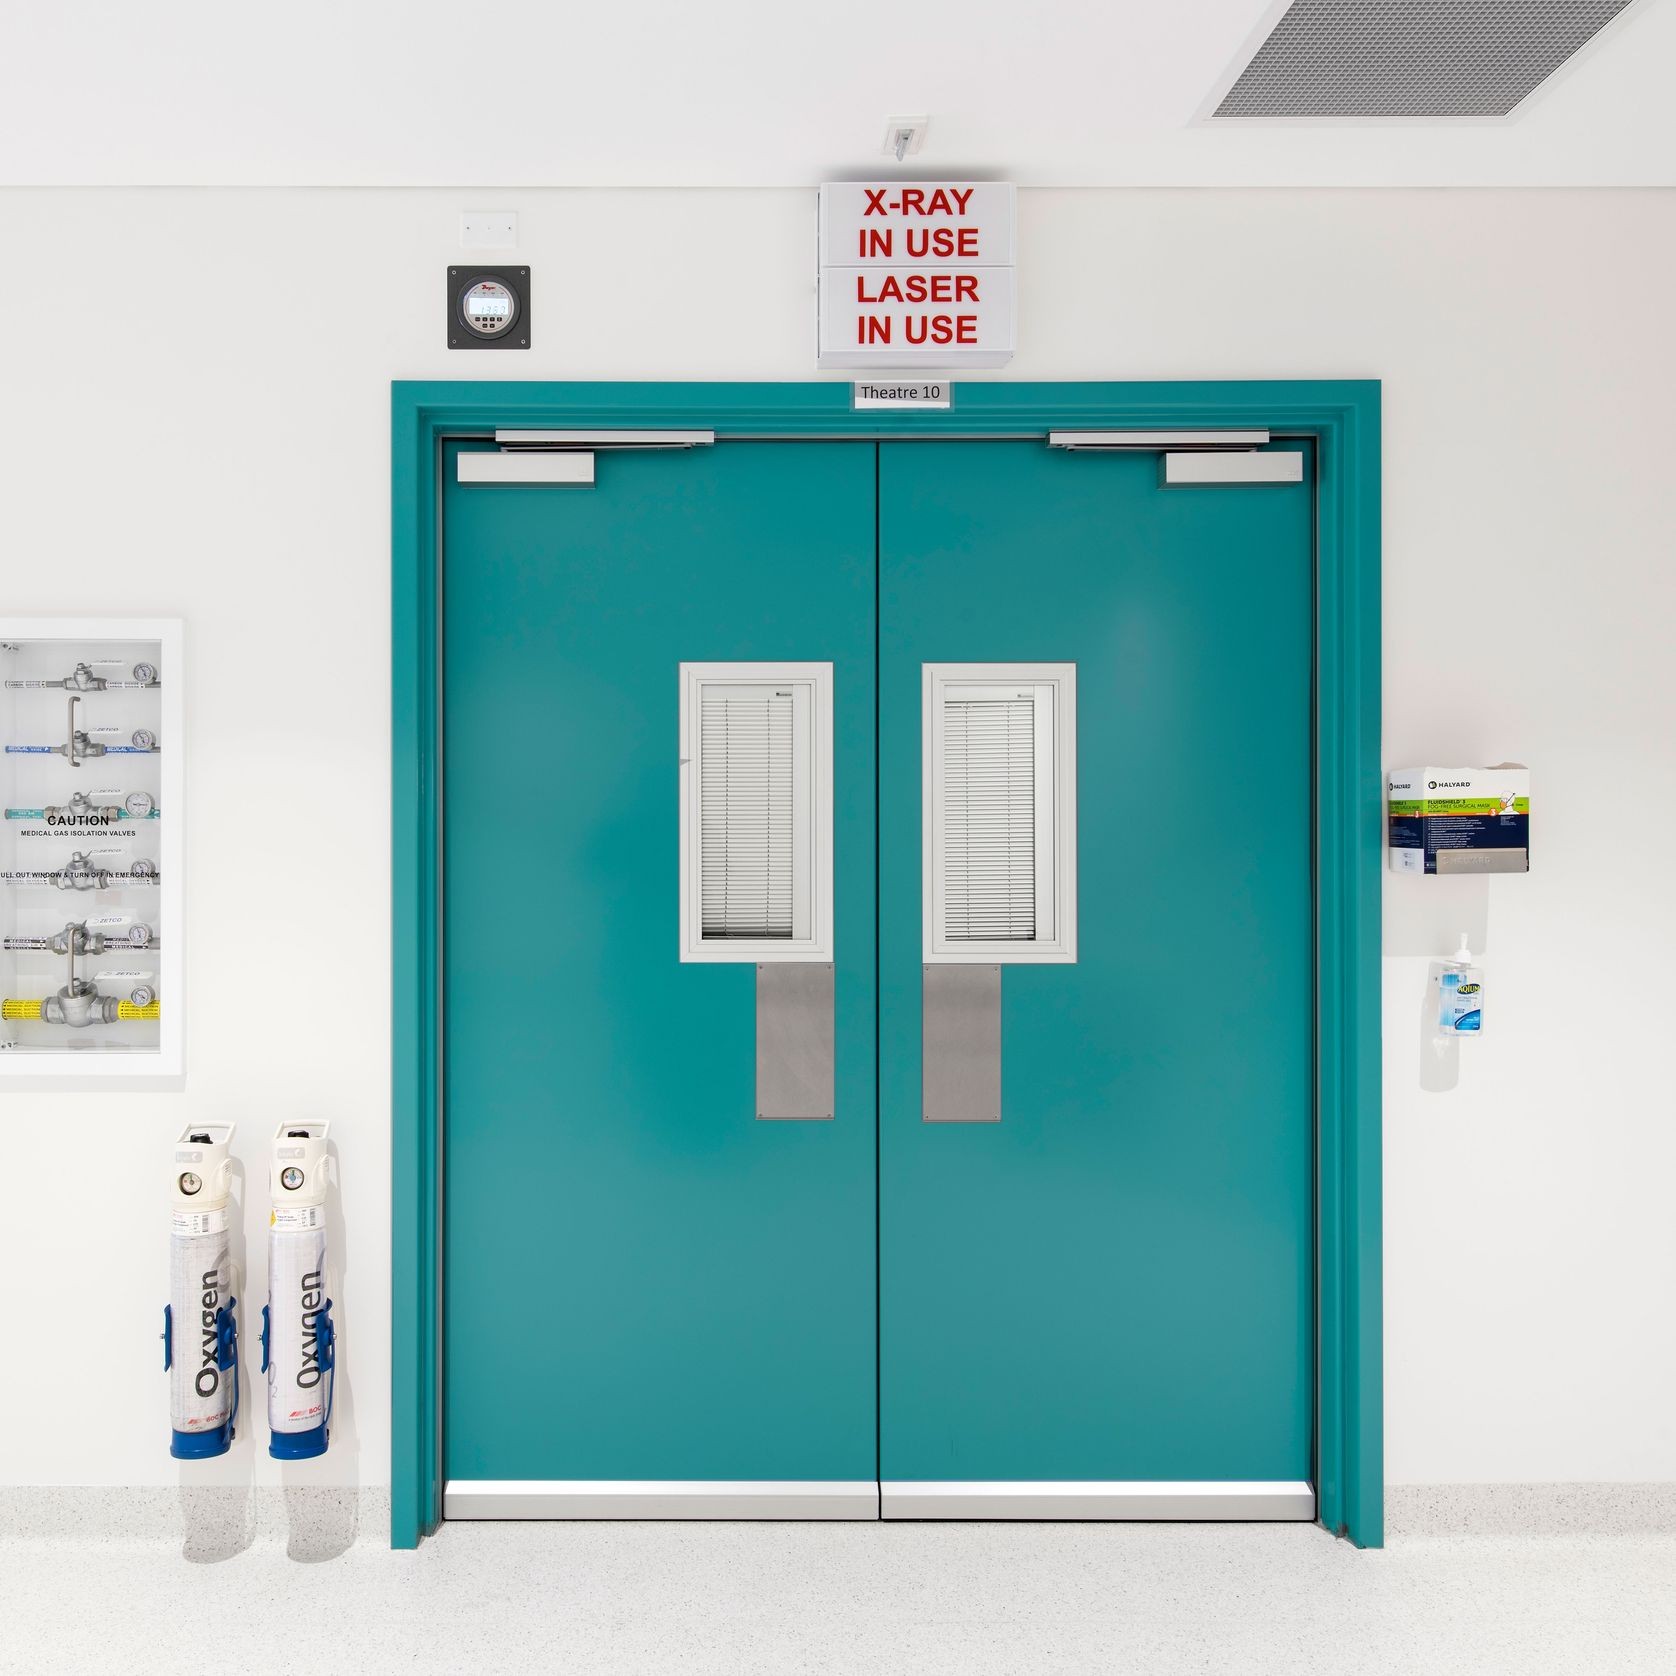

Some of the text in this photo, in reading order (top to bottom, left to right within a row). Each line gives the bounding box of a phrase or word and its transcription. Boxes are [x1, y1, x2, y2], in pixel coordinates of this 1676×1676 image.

[864, 189, 974, 216] X-RAY
[859, 228, 979, 257] IN USE
[857, 275, 980, 303] LASER
[858, 315, 978, 344] IN USE
[861, 386, 940, 399] Theatre 10
[47, 815, 109, 826] CAUTION
[195, 1269, 222, 1398] Oxygen
